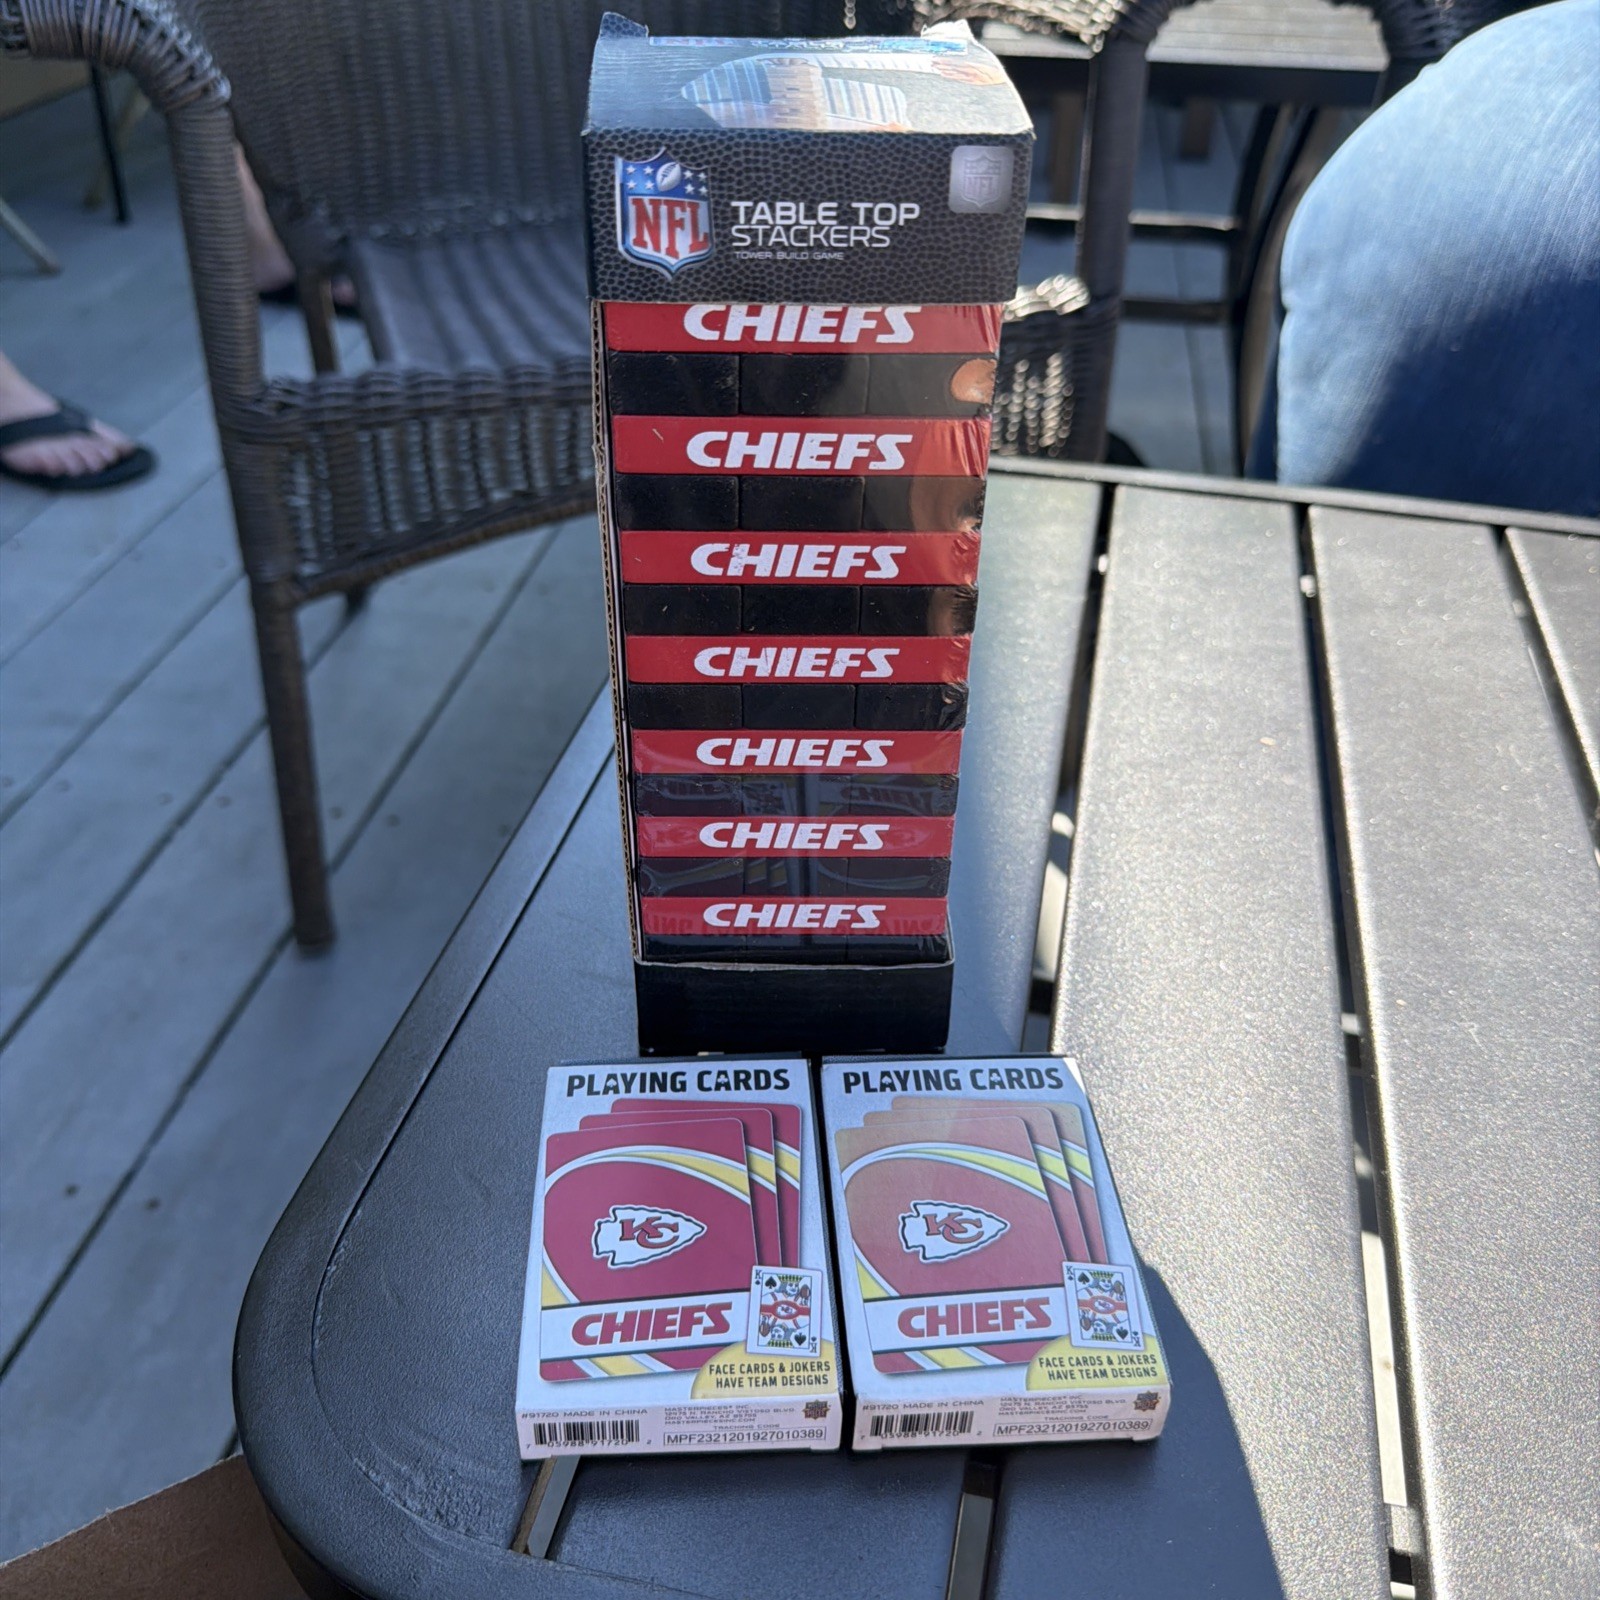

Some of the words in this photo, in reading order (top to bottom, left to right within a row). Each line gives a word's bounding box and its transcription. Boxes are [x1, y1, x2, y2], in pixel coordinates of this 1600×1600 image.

[731, 201, 838, 226] TABLE
[851, 202, 920, 226] TOP
[631, 197, 710, 260] NFL
[731, 225, 890, 248] STACKERS
[735, 251, 773, 260] TOWER
[776, 251, 809, 260] BUILD
[813, 252, 844, 261] GAME
[684, 305, 922, 343] CHIEFS
[687, 432, 913, 470] CHIEFS
[691, 543, 906, 579] CHIEFS
[694, 647, 899, 678] CHIEFS
[697, 738, 894, 768] CHIEFS
[700, 823, 890, 850] CHIEFS
[704, 904, 886, 928] CHIEFS
[567, 1071, 687, 1097] PLAYING
[697, 1069, 790, 1092] CARDS
[843, 1069, 962, 1094] PLAYING
[970, 1067, 1063, 1090] CARDS
[619, 1215, 680, 1249] KC
[924, 1212, 984, 1244] KC
[755, 1269, 762, 1279] K
[1066, 1266, 1074, 1275] K
[571, 1301, 733, 1346] CHIEFS
[897, 1297, 1052, 1338] CHIEFS
[709, 1363, 736, 1375] FACE
[739, 1362, 775, 1374] CARDS
[778, 1361, 786, 1373] &
[789, 1361, 831, 1373] JOKERS
[1038, 1356, 1065, 1368] FACE
[1068, 1355, 1103, 1367] CARDS
[1106, 1355, 1114, 1367] &
[1117, 1354, 1157, 1366] JOKERS
[1048, 1369, 1076, 1381] HAVE
[1078, 1368, 1109, 1380] TEAM
[1112, 1366, 1158, 1379] DESIGNS
[716, 1377, 744, 1389] HAVE
[748, 1376, 778, 1388] TEAM
[782, 1375, 829, 1387] DESIGNS
[667, 1429, 823, 1444] MPF2321201927010389
[997, 1421, 1149, 1436] MPF2321201927010389
